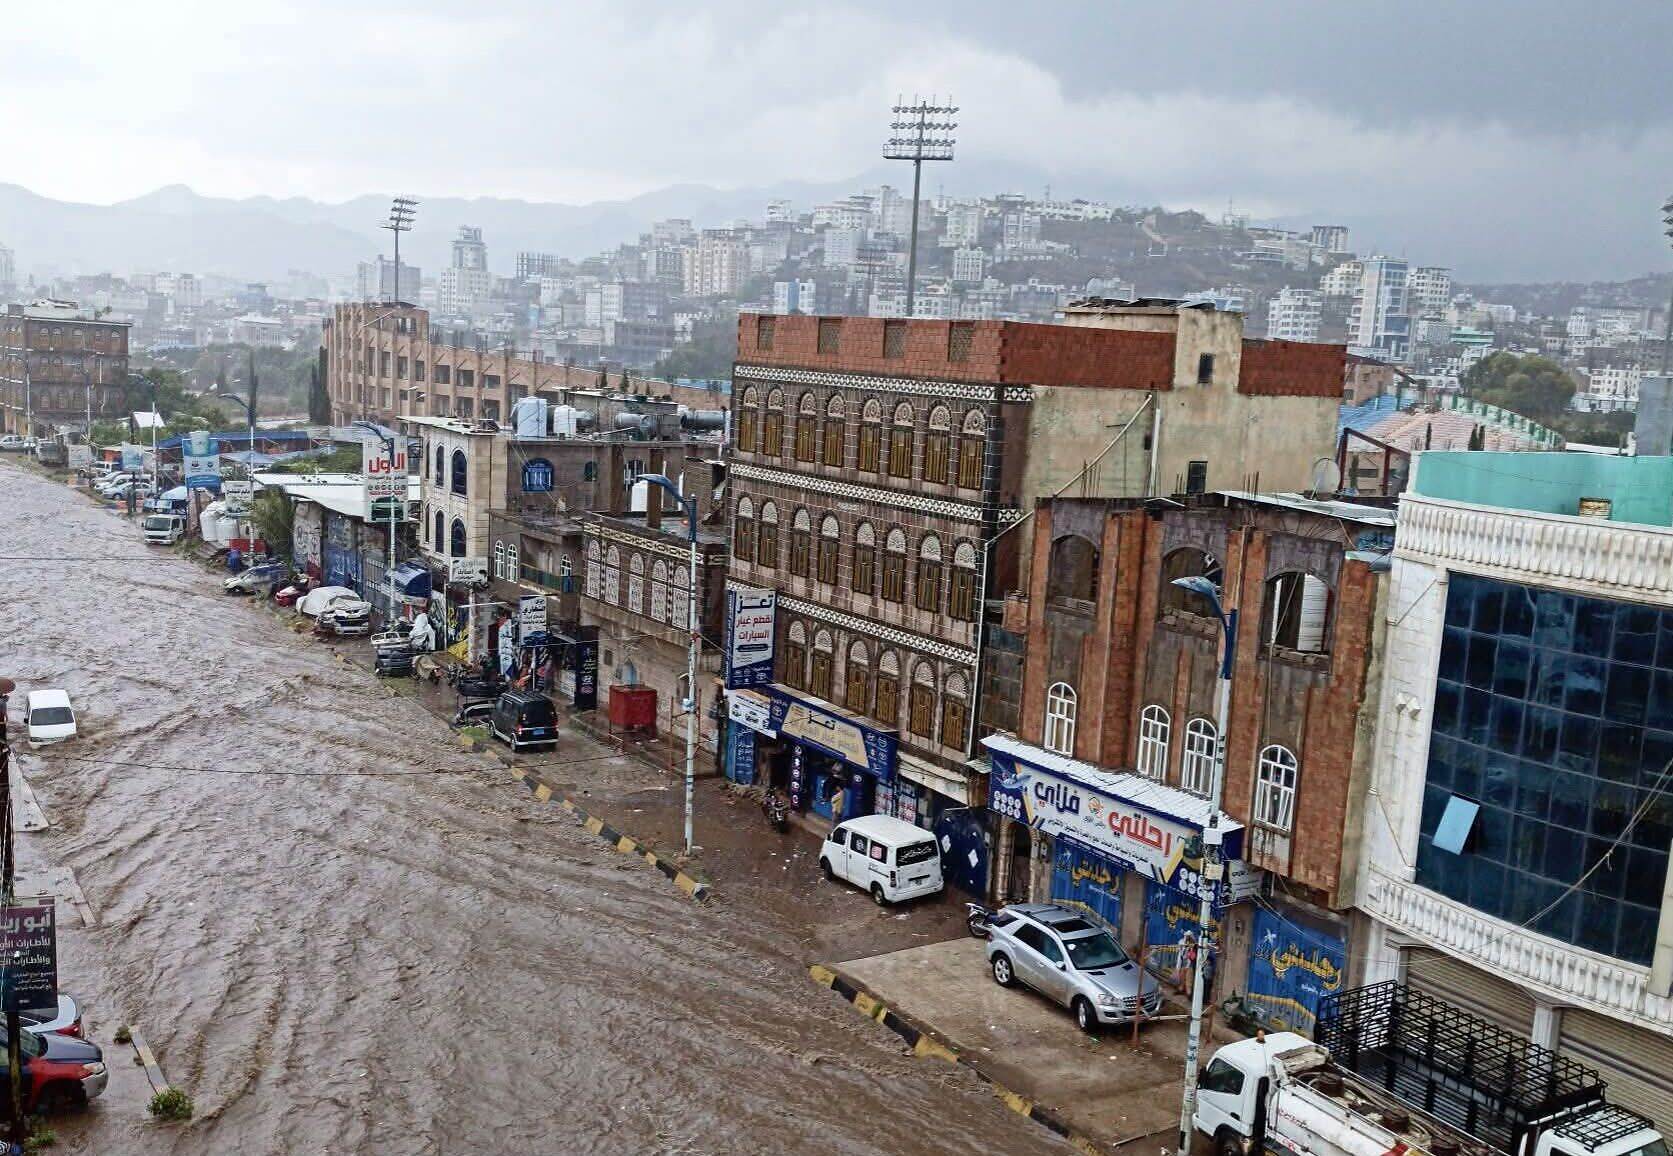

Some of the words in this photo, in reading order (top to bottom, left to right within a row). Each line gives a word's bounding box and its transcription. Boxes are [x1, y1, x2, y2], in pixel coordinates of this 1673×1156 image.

[737, 595, 774, 613] تعز
[738, 630, 769, 642] السيارات
[806, 710, 837, 731] تعز
[1108, 810, 1171, 857] رحلتي
[23, 907, 52, 933] أبو
